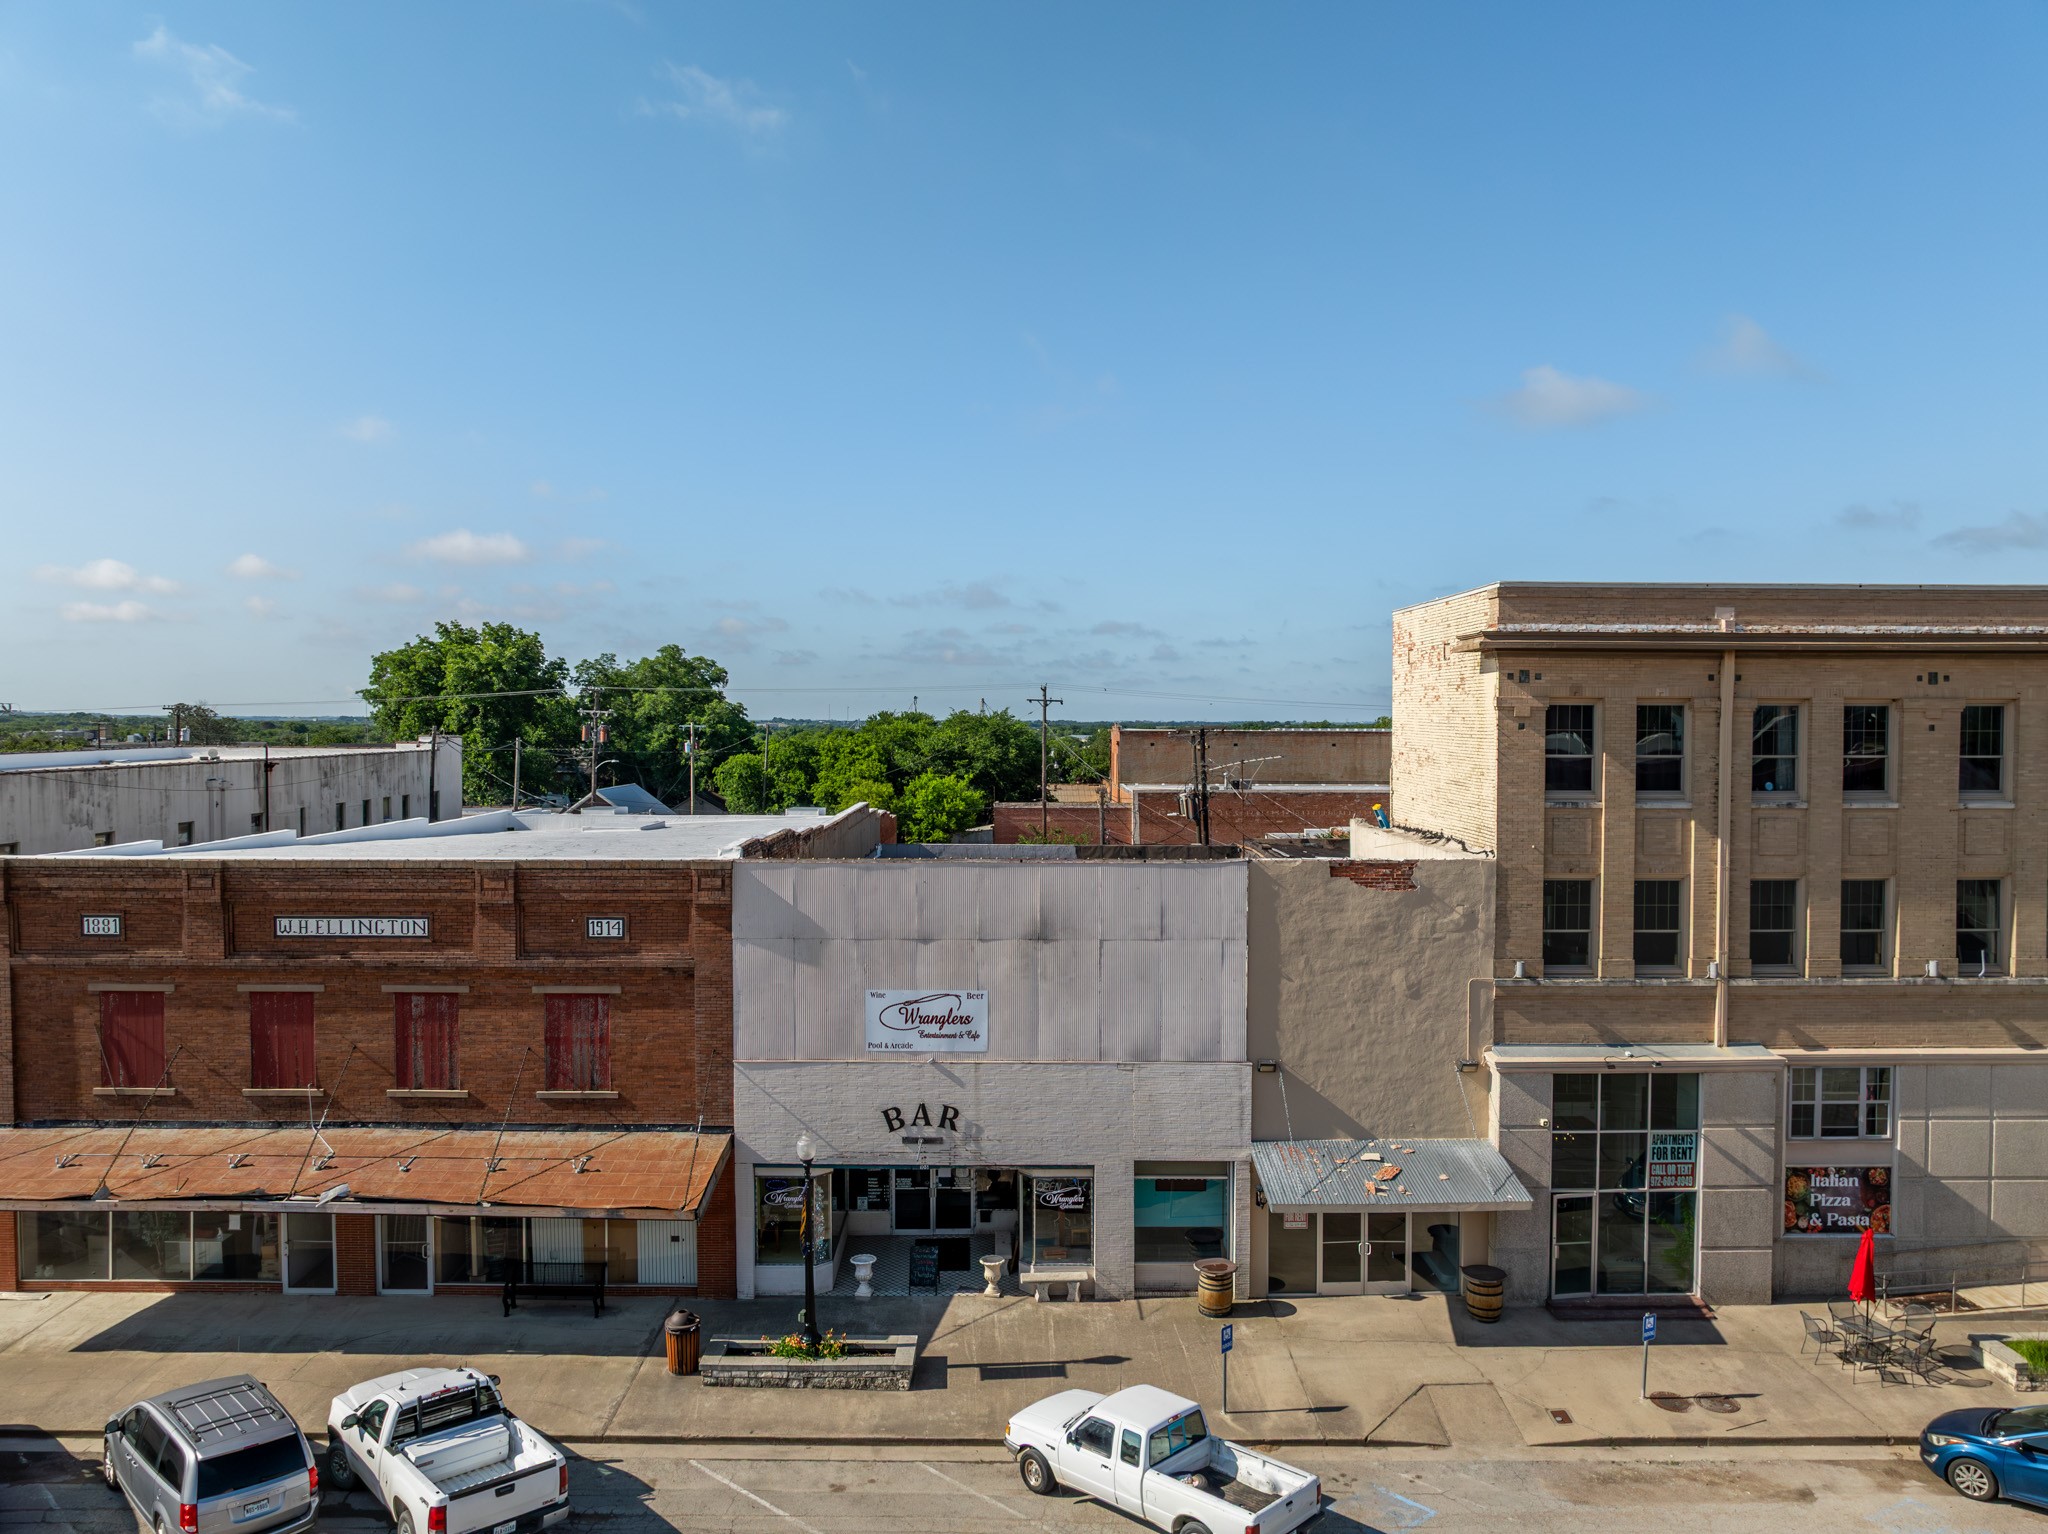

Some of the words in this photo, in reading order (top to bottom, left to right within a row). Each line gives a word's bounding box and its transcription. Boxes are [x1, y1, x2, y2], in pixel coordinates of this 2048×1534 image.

[84, 918, 119, 934] 1881
[589, 920, 622, 936] 1914
[869, 991, 887, 999] Wine
[966, 992, 984, 1000] Beer
[898, 1006, 974, 1031] Wranglers
[917, 1029, 958, 1039] Entertainment
[958, 1031, 965, 1039] &
[867, 1041, 883, 1049] Pool
[881, 1102, 959, 1134] BAR
[1651, 1133, 1694, 1146] APARTMENTS
[1651, 1146, 1668, 1161] FOR
[1670, 1146, 1694, 1161] RENT
[1651, 1163, 1666, 1175] CALL
[1667, 1163, 1677, 1175] OR
[1677, 1163, 1693, 1175] TEXT
[1810, 1173, 1859, 1187] Italian
[1046, 1193, 1085, 1204] Wranglers
[1809, 1193, 1851, 1207] Pizza
[1809, 1212, 1823, 1226] &
[1826, 1212, 1870, 1226] Pasta
[542, 1497, 557, 1506] GMC
